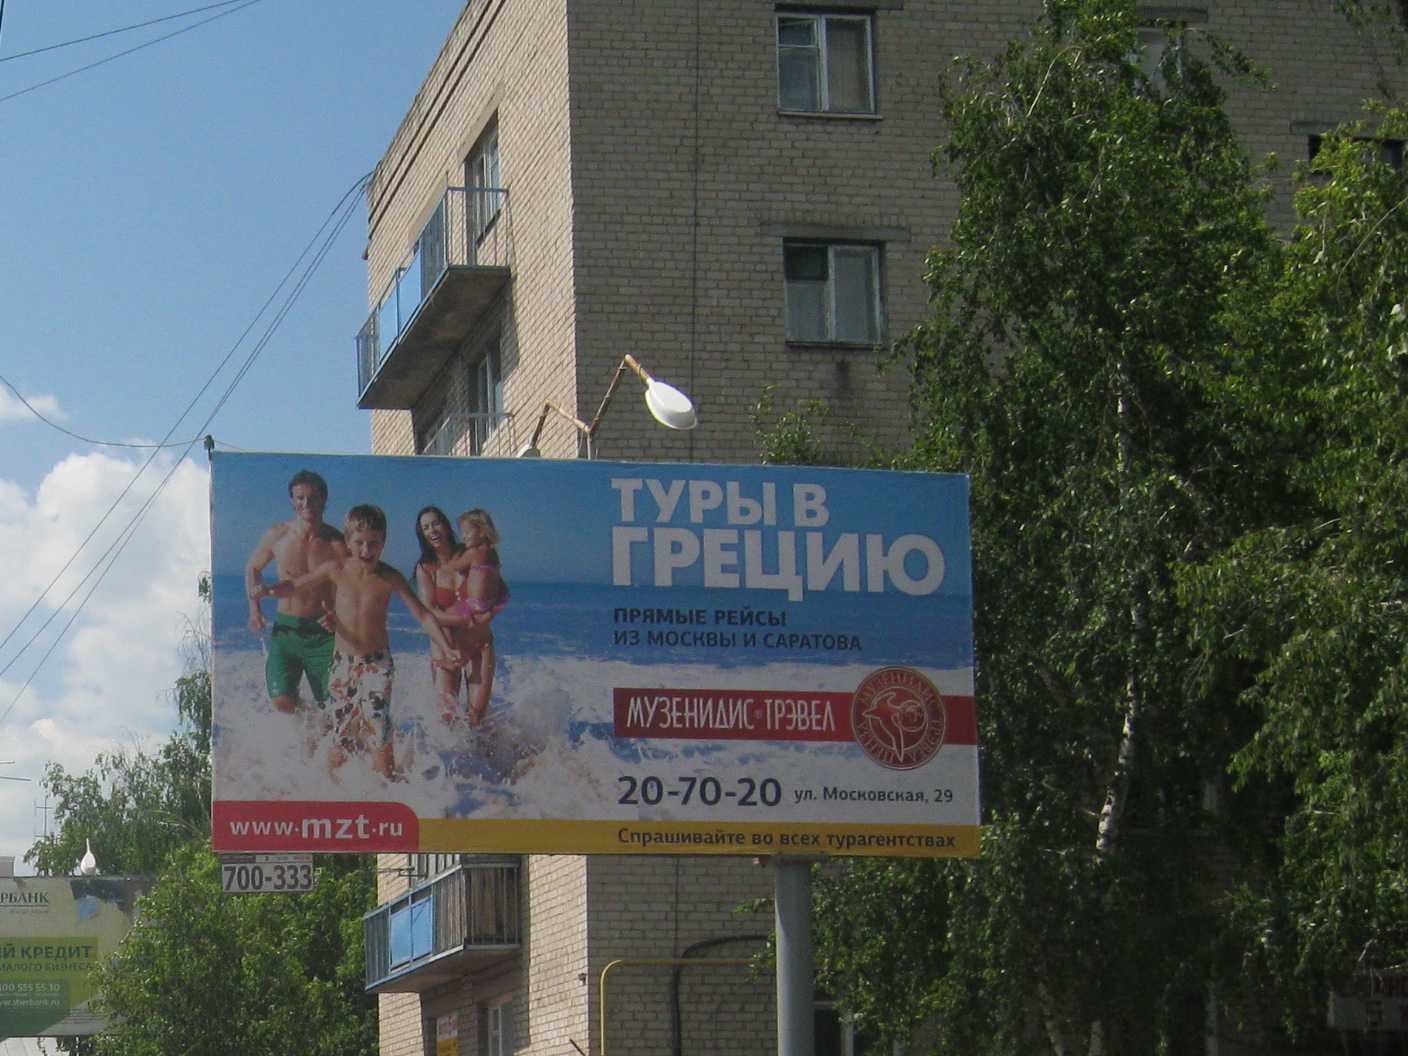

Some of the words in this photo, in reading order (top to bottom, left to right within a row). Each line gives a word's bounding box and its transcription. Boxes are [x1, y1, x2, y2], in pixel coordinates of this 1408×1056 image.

[610, 477, 777, 526] ТУРЫ
[792, 483, 830, 528] В
[611, 526, 946, 602] ГРЕЦИЮ
[613, 607, 707, 625] ПРЯМЫЕ
[714, 607, 787, 627] РЕЙСЫ
[613, 631, 641, 647] ИЗ
[647, 631, 736, 648] МОСКВЫ
[742, 632, 757, 648] И
[763, 632, 863, 651] САРАТОВА
[626, 696, 754, 730] МУЗЕНИДИС
[764, 698, 836, 732] ТРЭВЕЛ
[617, 775, 782, 807] 20-70-20
[793, 788, 818, 804] ул.
[823, 786, 930, 804] Московская,
[934, 788, 954, 803] 29
[617, 827, 746, 848] Спрашивайте
[752, 834, 774, 846] во
[780, 834, 820, 847] всех
[826, 834, 956, 851] турагентствах
[223, 864, 312, 890] 700-333
[20, 945, 92, 960] КРЕДИТ
